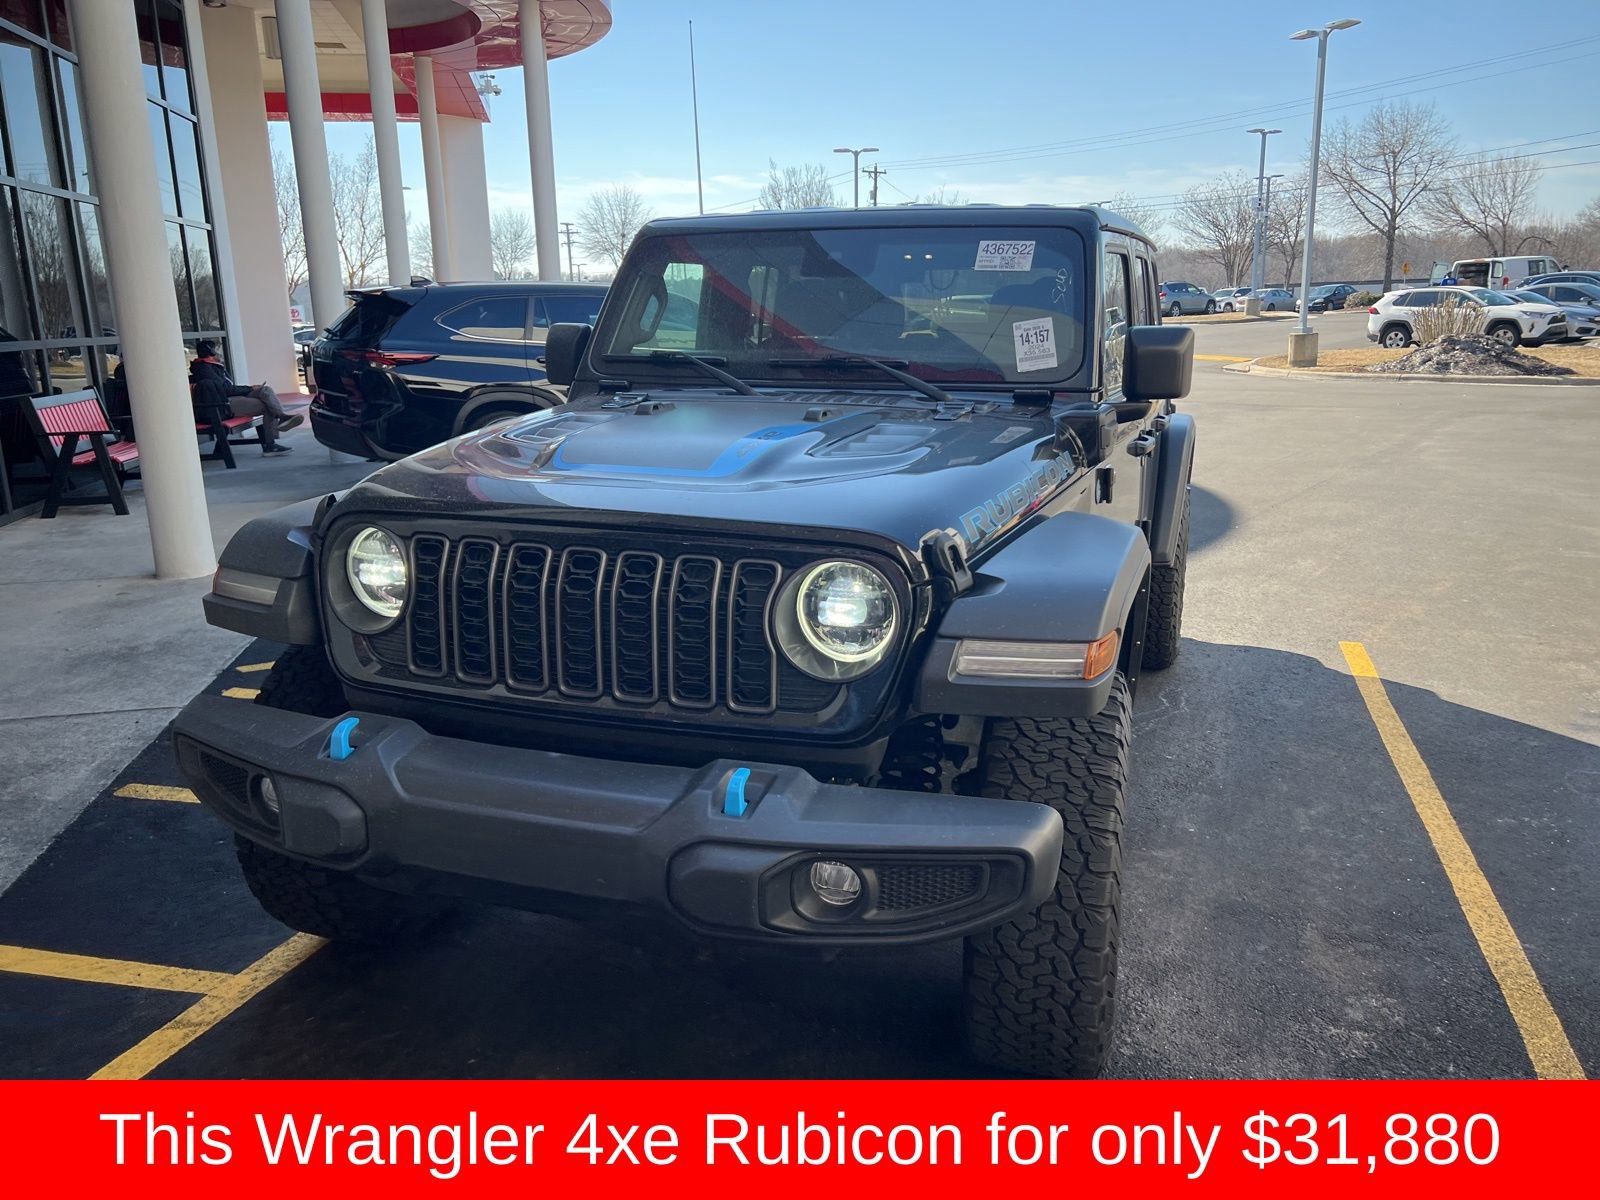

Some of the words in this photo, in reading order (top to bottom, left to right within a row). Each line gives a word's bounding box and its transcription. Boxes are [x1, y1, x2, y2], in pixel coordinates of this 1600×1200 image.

[982, 243, 1033, 255] 4367522
[1019, 329, 1050, 346] 14:157
[959, 451, 1075, 543] RUBICON
